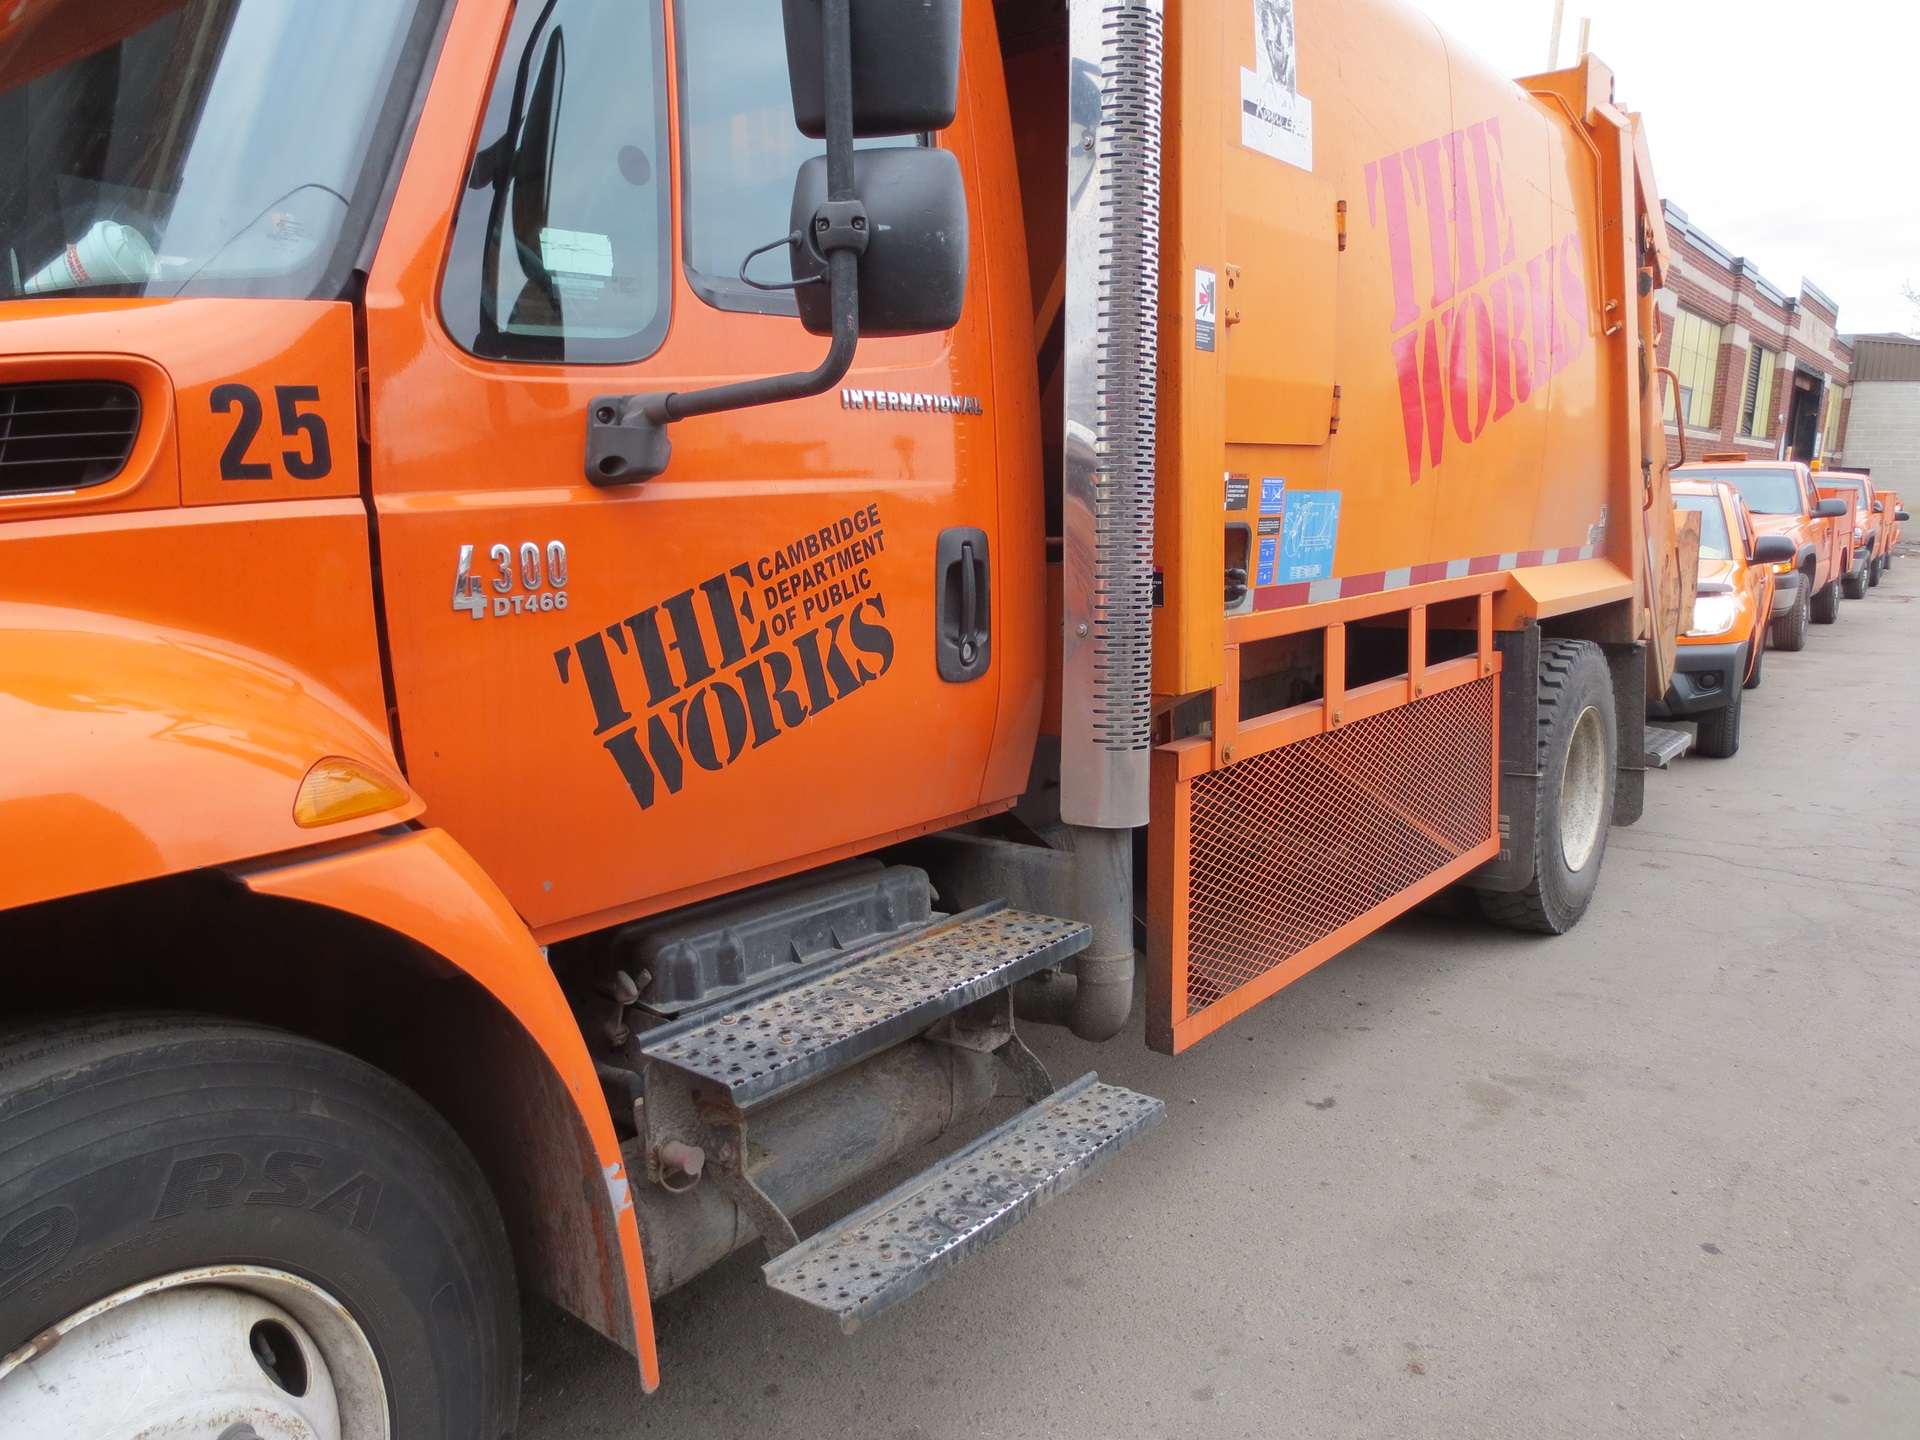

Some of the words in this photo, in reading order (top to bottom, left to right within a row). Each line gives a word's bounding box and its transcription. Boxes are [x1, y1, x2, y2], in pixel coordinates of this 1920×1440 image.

[1363, 117, 1516, 334] THE
[1391, 232, 1587, 486] WORKS
[209, 383, 332, 480] 25
[841, 389, 983, 415] INTERNATIONAL
[453, 540, 568, 619] 4300
[757, 503, 881, 581] CAMBRIDGE
[763, 529, 885, 611] DEPARTMENT
[494, 591, 568, 617] DT466
[771, 605, 797, 636] OF
[802, 568, 871, 621] PUBLIC
[553, 561, 770, 735] THE
[603, 593, 895, 810] WORKS
[154, 1151, 384, 1236] RSA
